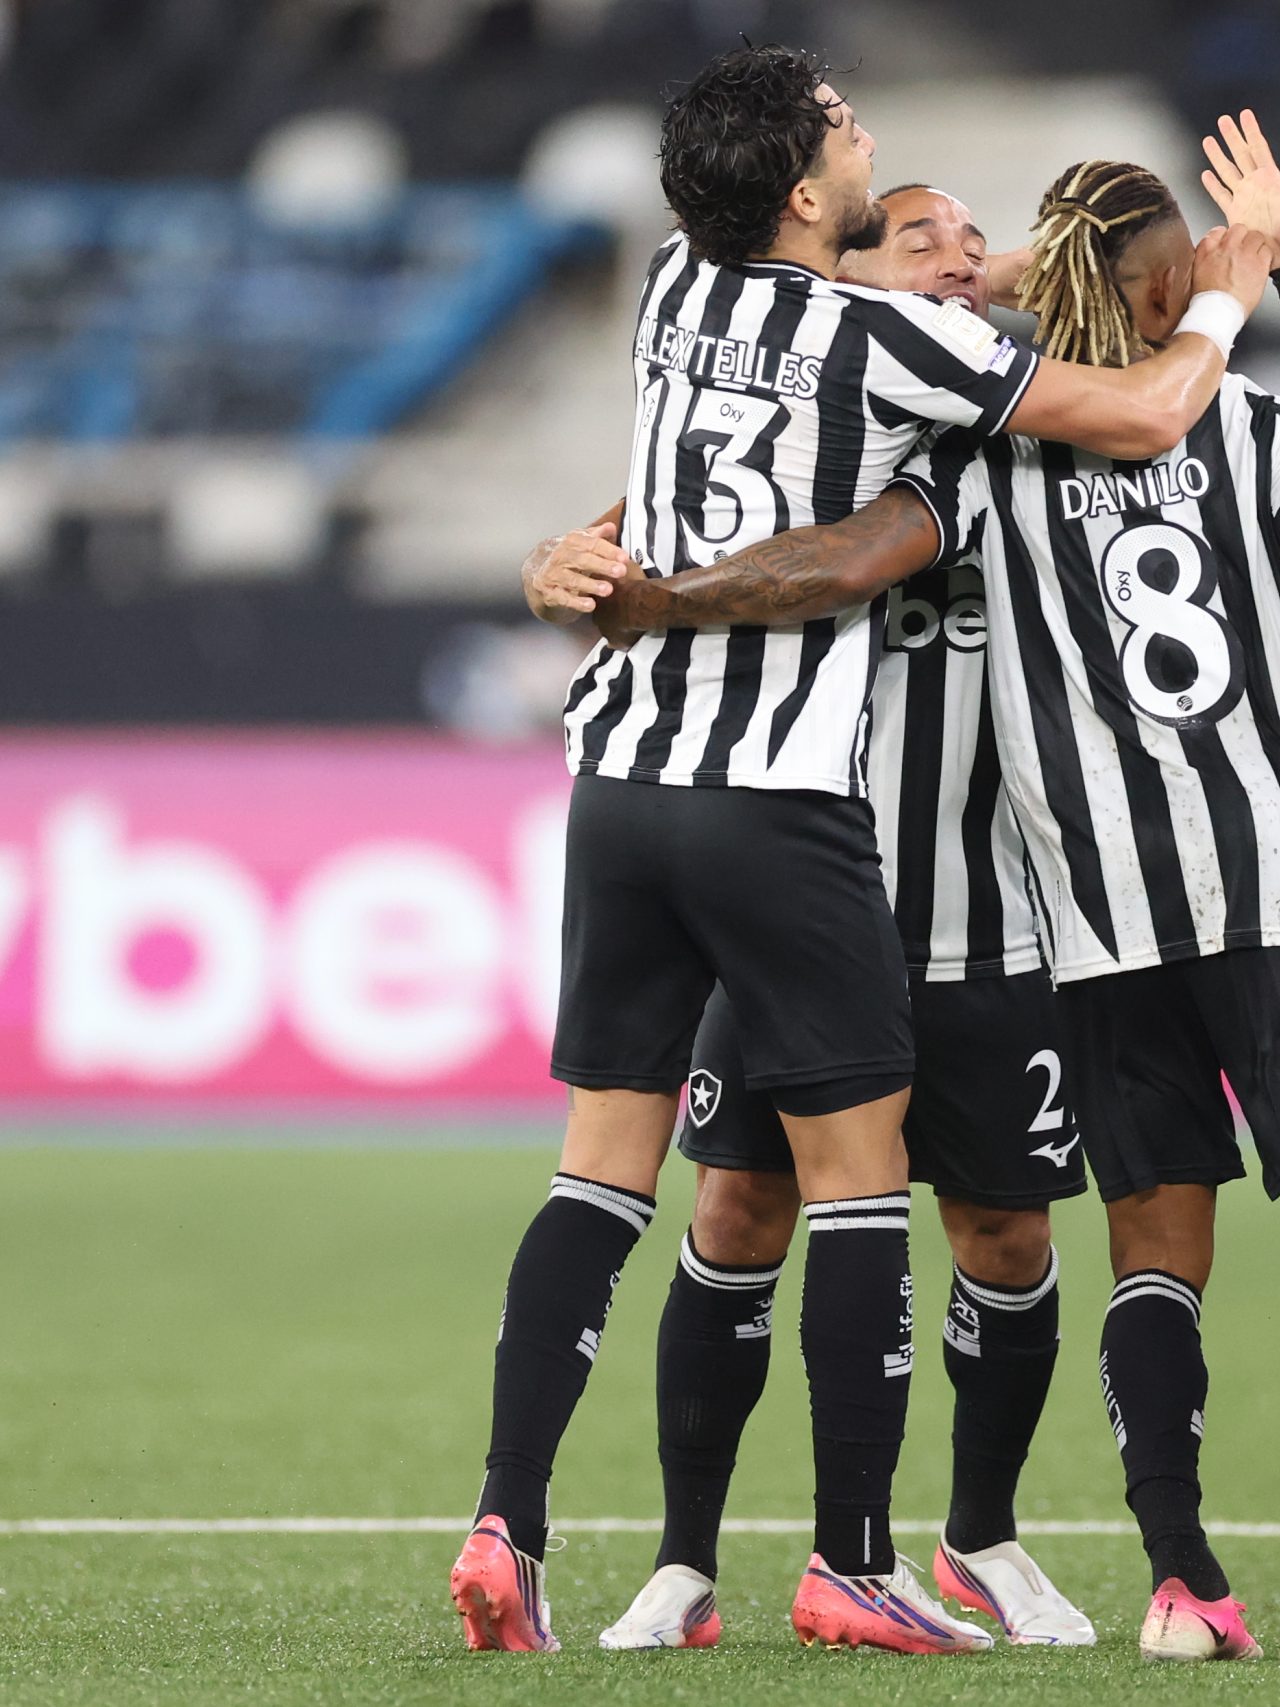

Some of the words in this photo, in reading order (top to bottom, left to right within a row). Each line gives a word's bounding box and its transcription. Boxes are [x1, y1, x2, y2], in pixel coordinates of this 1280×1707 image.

[634, 317, 694, 373] ALEX
[694, 334, 824, 400] TELLES
[628, 376, 784, 569] 13
[1058, 457, 1210, 520] DANILO
[887, 586, 988, 649] be
[1103, 524, 1238, 722] 8
[1025, 1048, 1077, 1133] 2
